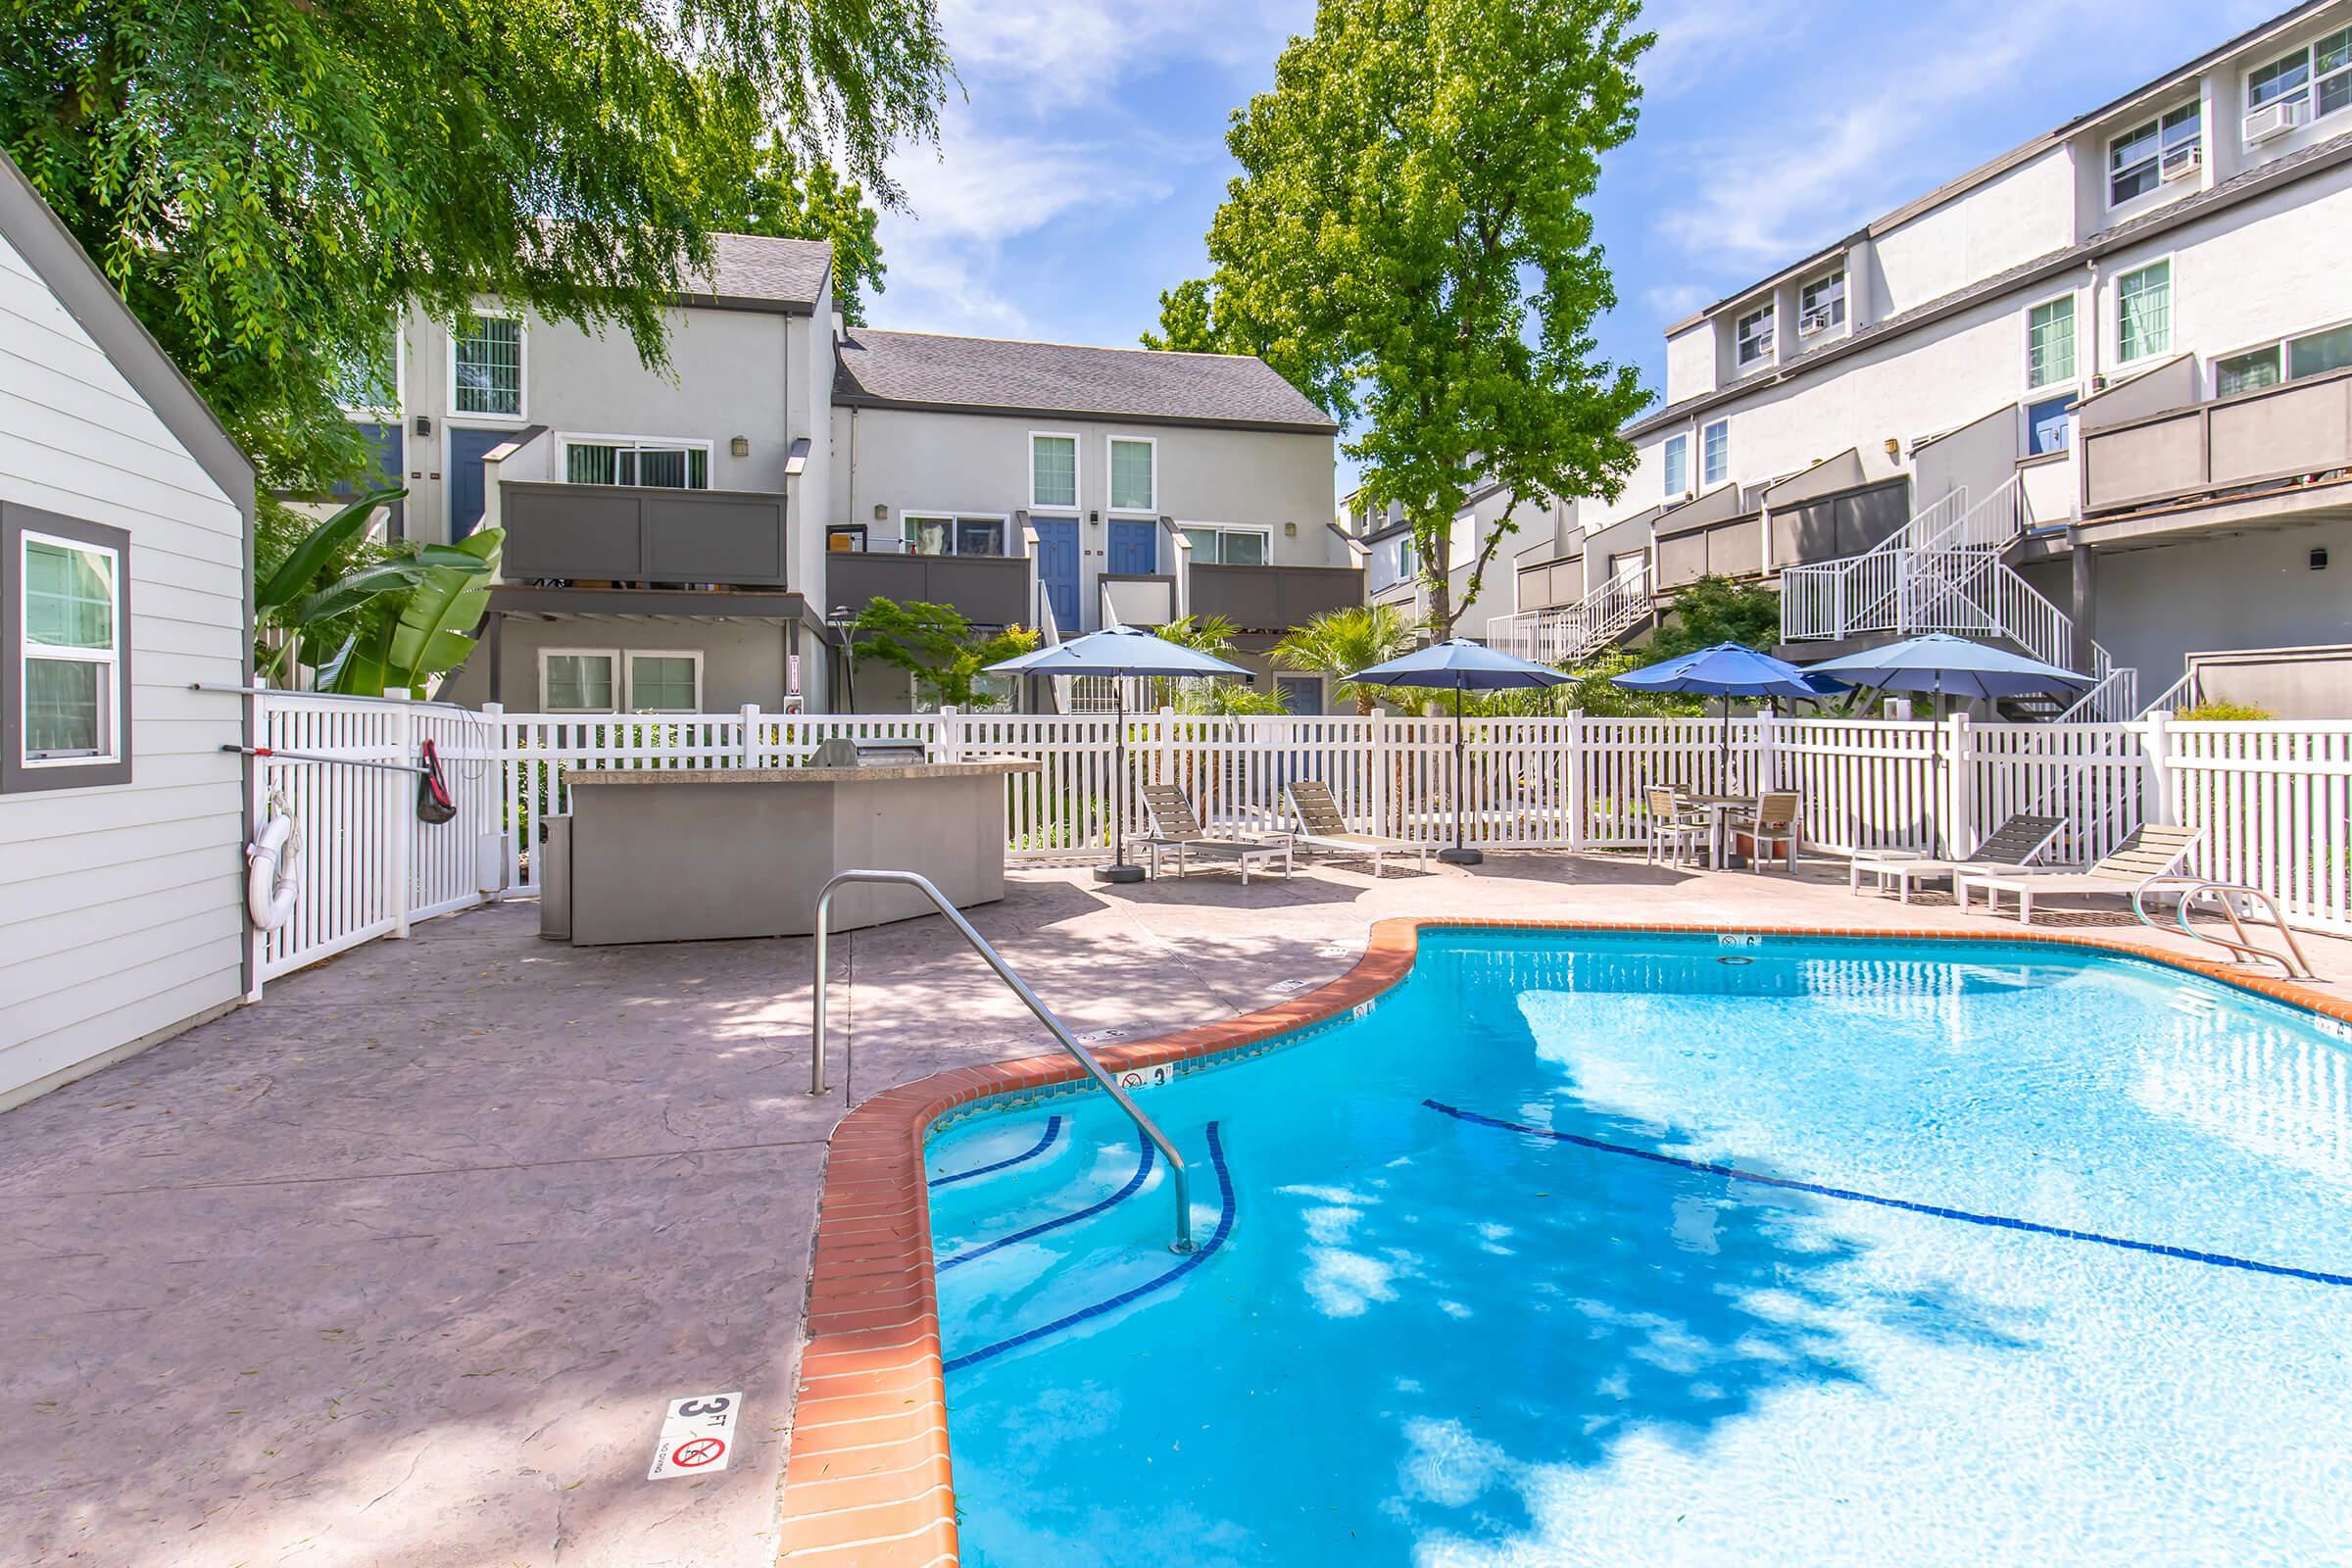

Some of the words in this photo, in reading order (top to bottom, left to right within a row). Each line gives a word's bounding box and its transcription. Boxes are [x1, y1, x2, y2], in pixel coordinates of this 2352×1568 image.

[1154, 1067, 1165, 1086] 3
[678, 1397, 730, 1417] 3
[708, 1414, 727, 1427] FT
